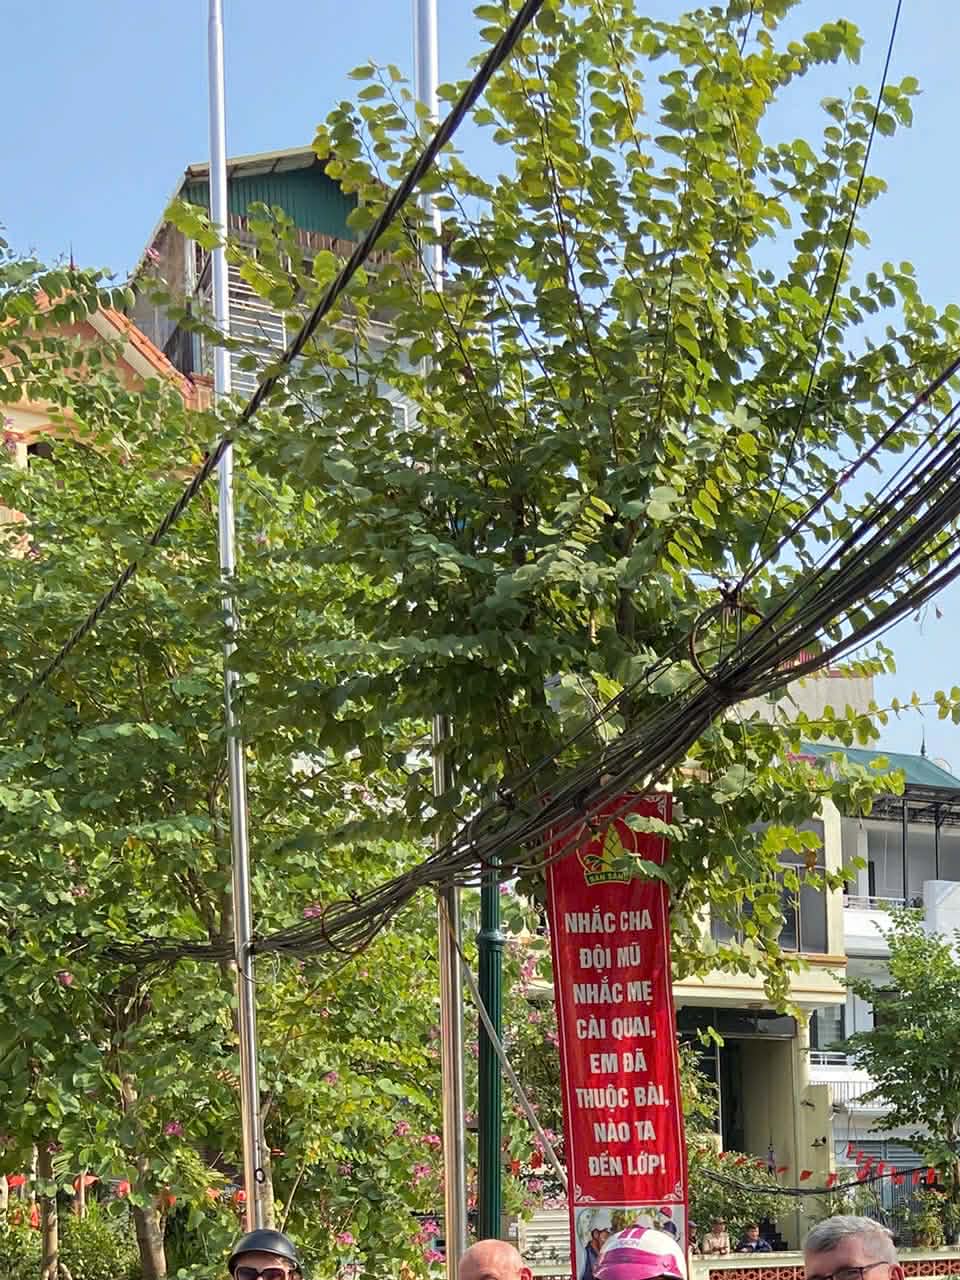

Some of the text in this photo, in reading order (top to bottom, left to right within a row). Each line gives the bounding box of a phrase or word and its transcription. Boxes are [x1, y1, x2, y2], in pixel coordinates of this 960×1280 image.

[564, 905, 653, 933] NHẮC CHA
[579, 942, 641, 973] ĐỘI MŨ
[573, 975, 653, 1006] NHẮC MẸ
[576, 1014, 656, 1040] CÀI QUAI,
[589, 1048, 648, 1074] EM ĐÃ
[576, 1081, 670, 1112] THUỘC BÀI,
[593, 1118, 656, 1143] NÀO TA
[588, 1150, 667, 1177] ĐẾN LỚP!
